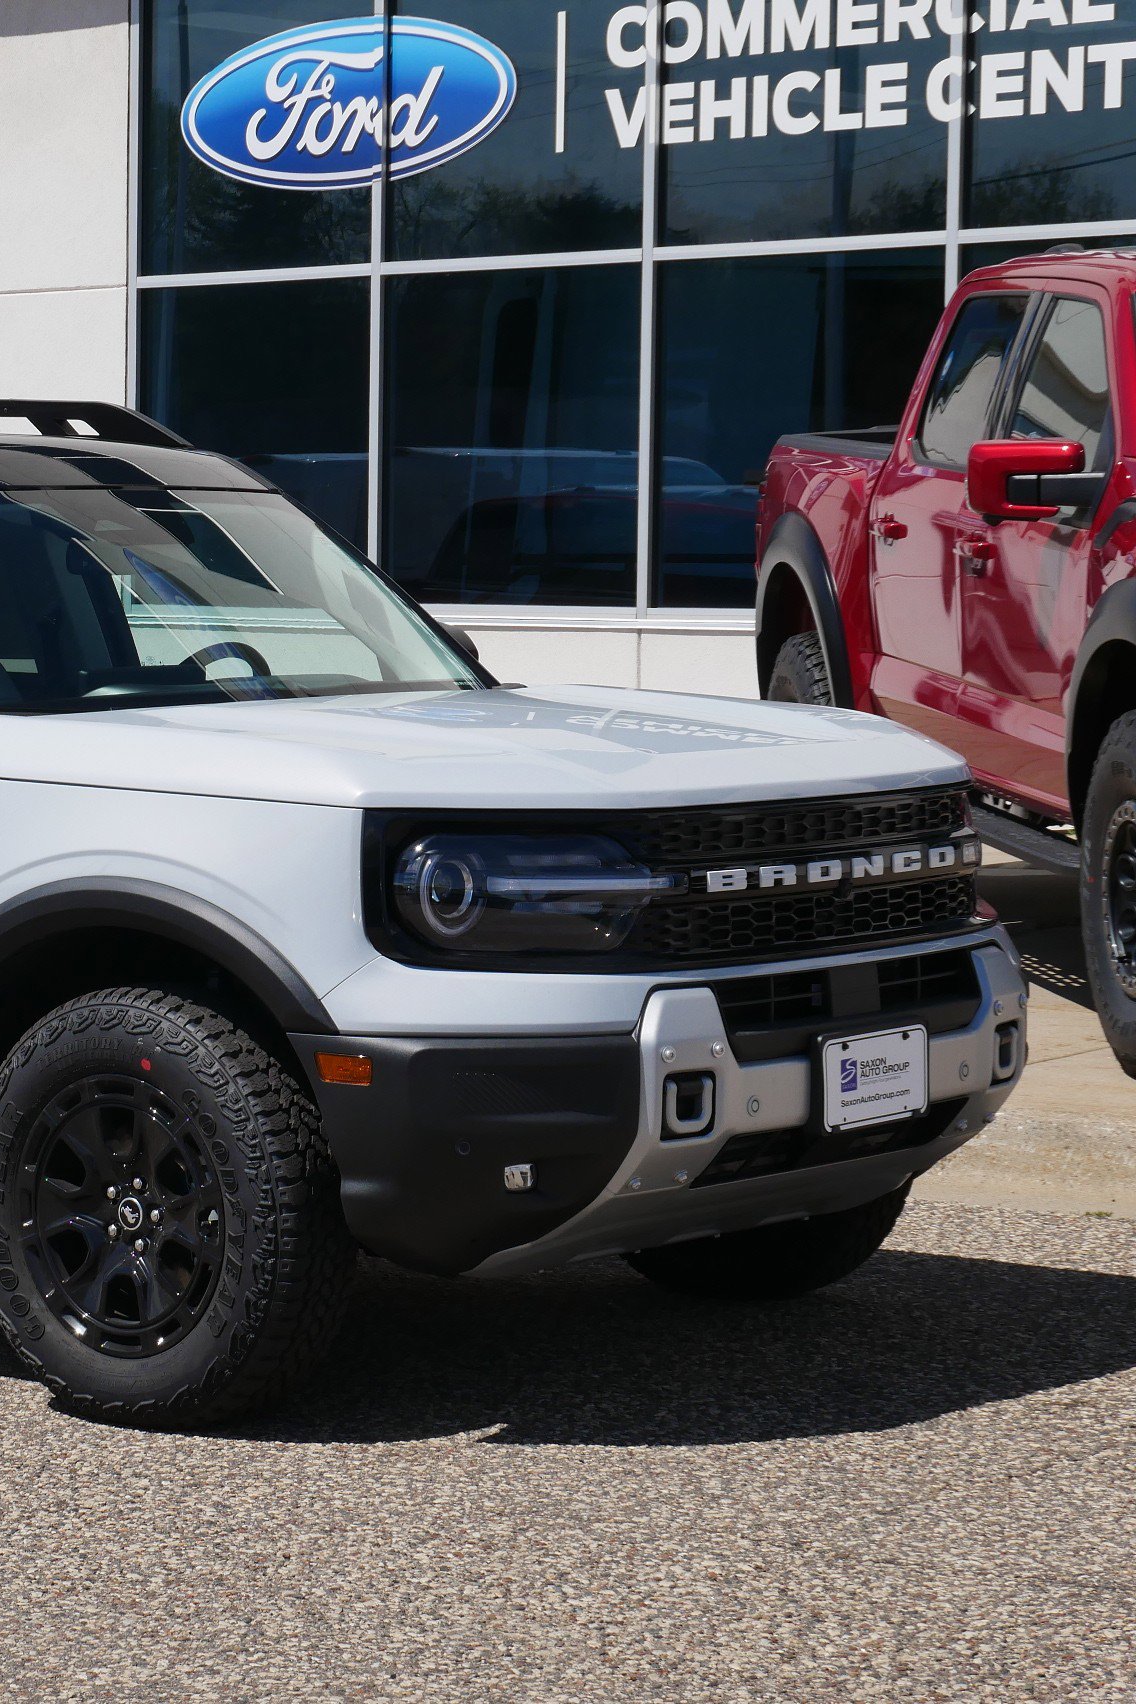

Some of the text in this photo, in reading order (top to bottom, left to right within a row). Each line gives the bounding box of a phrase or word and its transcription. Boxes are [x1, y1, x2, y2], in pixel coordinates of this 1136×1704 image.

[246, 46, 445, 160] Ford
[605, 42, 1136, 148] VEHICLE CENT
[706, 845, 955, 893] BRONCO
[860, 1057, 887, 1070] SAXON
[860, 1061, 910, 1079] AUTO GROUP
[840, 1088, 911, 1108] SaxonAutoGroup.com
